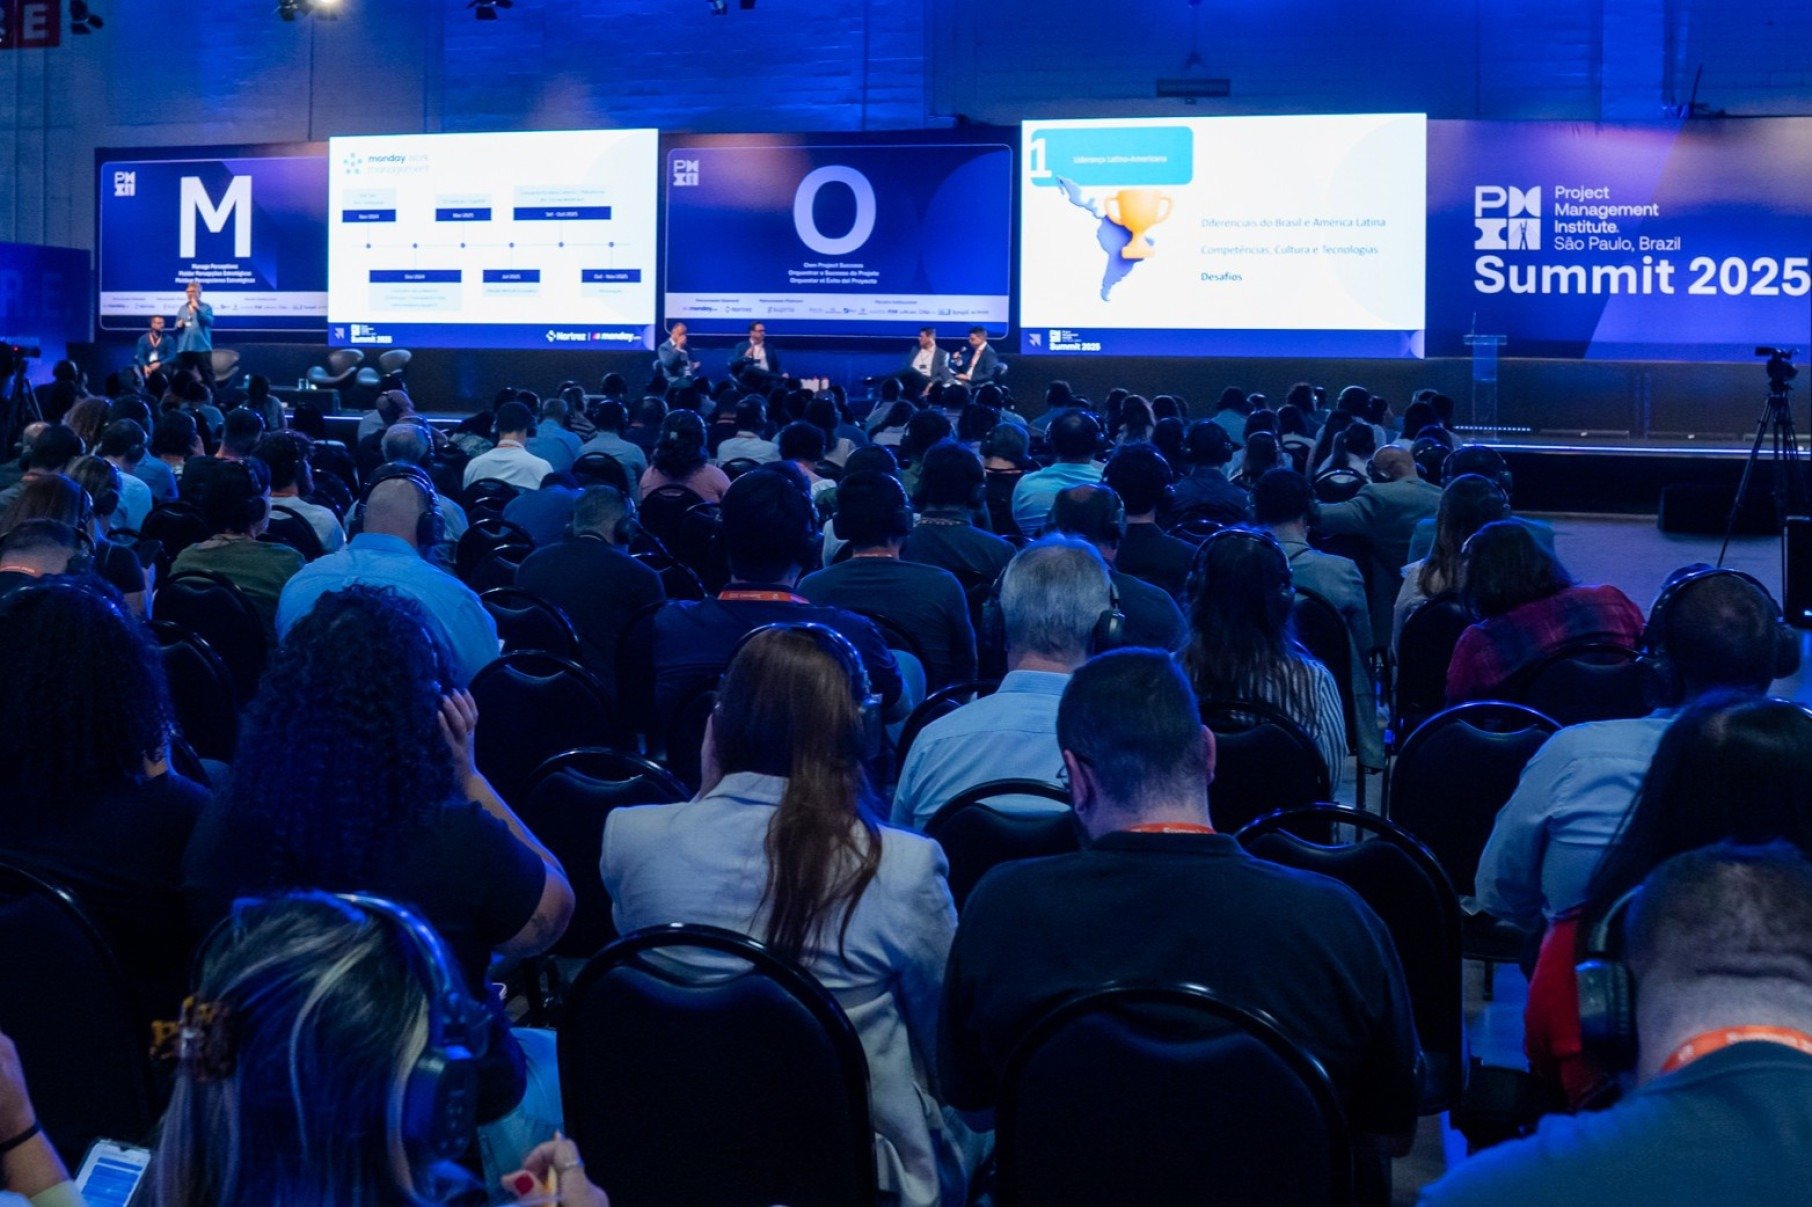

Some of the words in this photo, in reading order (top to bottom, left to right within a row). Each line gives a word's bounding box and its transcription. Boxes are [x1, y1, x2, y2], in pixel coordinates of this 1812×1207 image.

[368, 154, 406, 164] monday
[1554, 186, 1610, 201] Project
[179, 175, 252, 258] M
[793, 164, 877, 256] O
[1554, 203, 1660, 219] Management
[1275, 218, 1301, 227] Brasil
[1313, 218, 1353, 227] América
[1355, 218, 1386, 227] Latina
[1274, 245, 1310, 254] Cultura
[1322, 245, 1378, 256] Tecnologias
[1554, 236, 1585, 250] São
[1588, 236, 1635, 252] Paulo,
[1639, 236, 1681, 250] Brazil
[1200, 272, 1242, 281] Desafios
[1474, 255, 1675, 295] Summit
[1687, 256, 1811, 296] 2025
[1049, 342, 1081, 351] Summit
[1081, 342, 1101, 351] 2025
